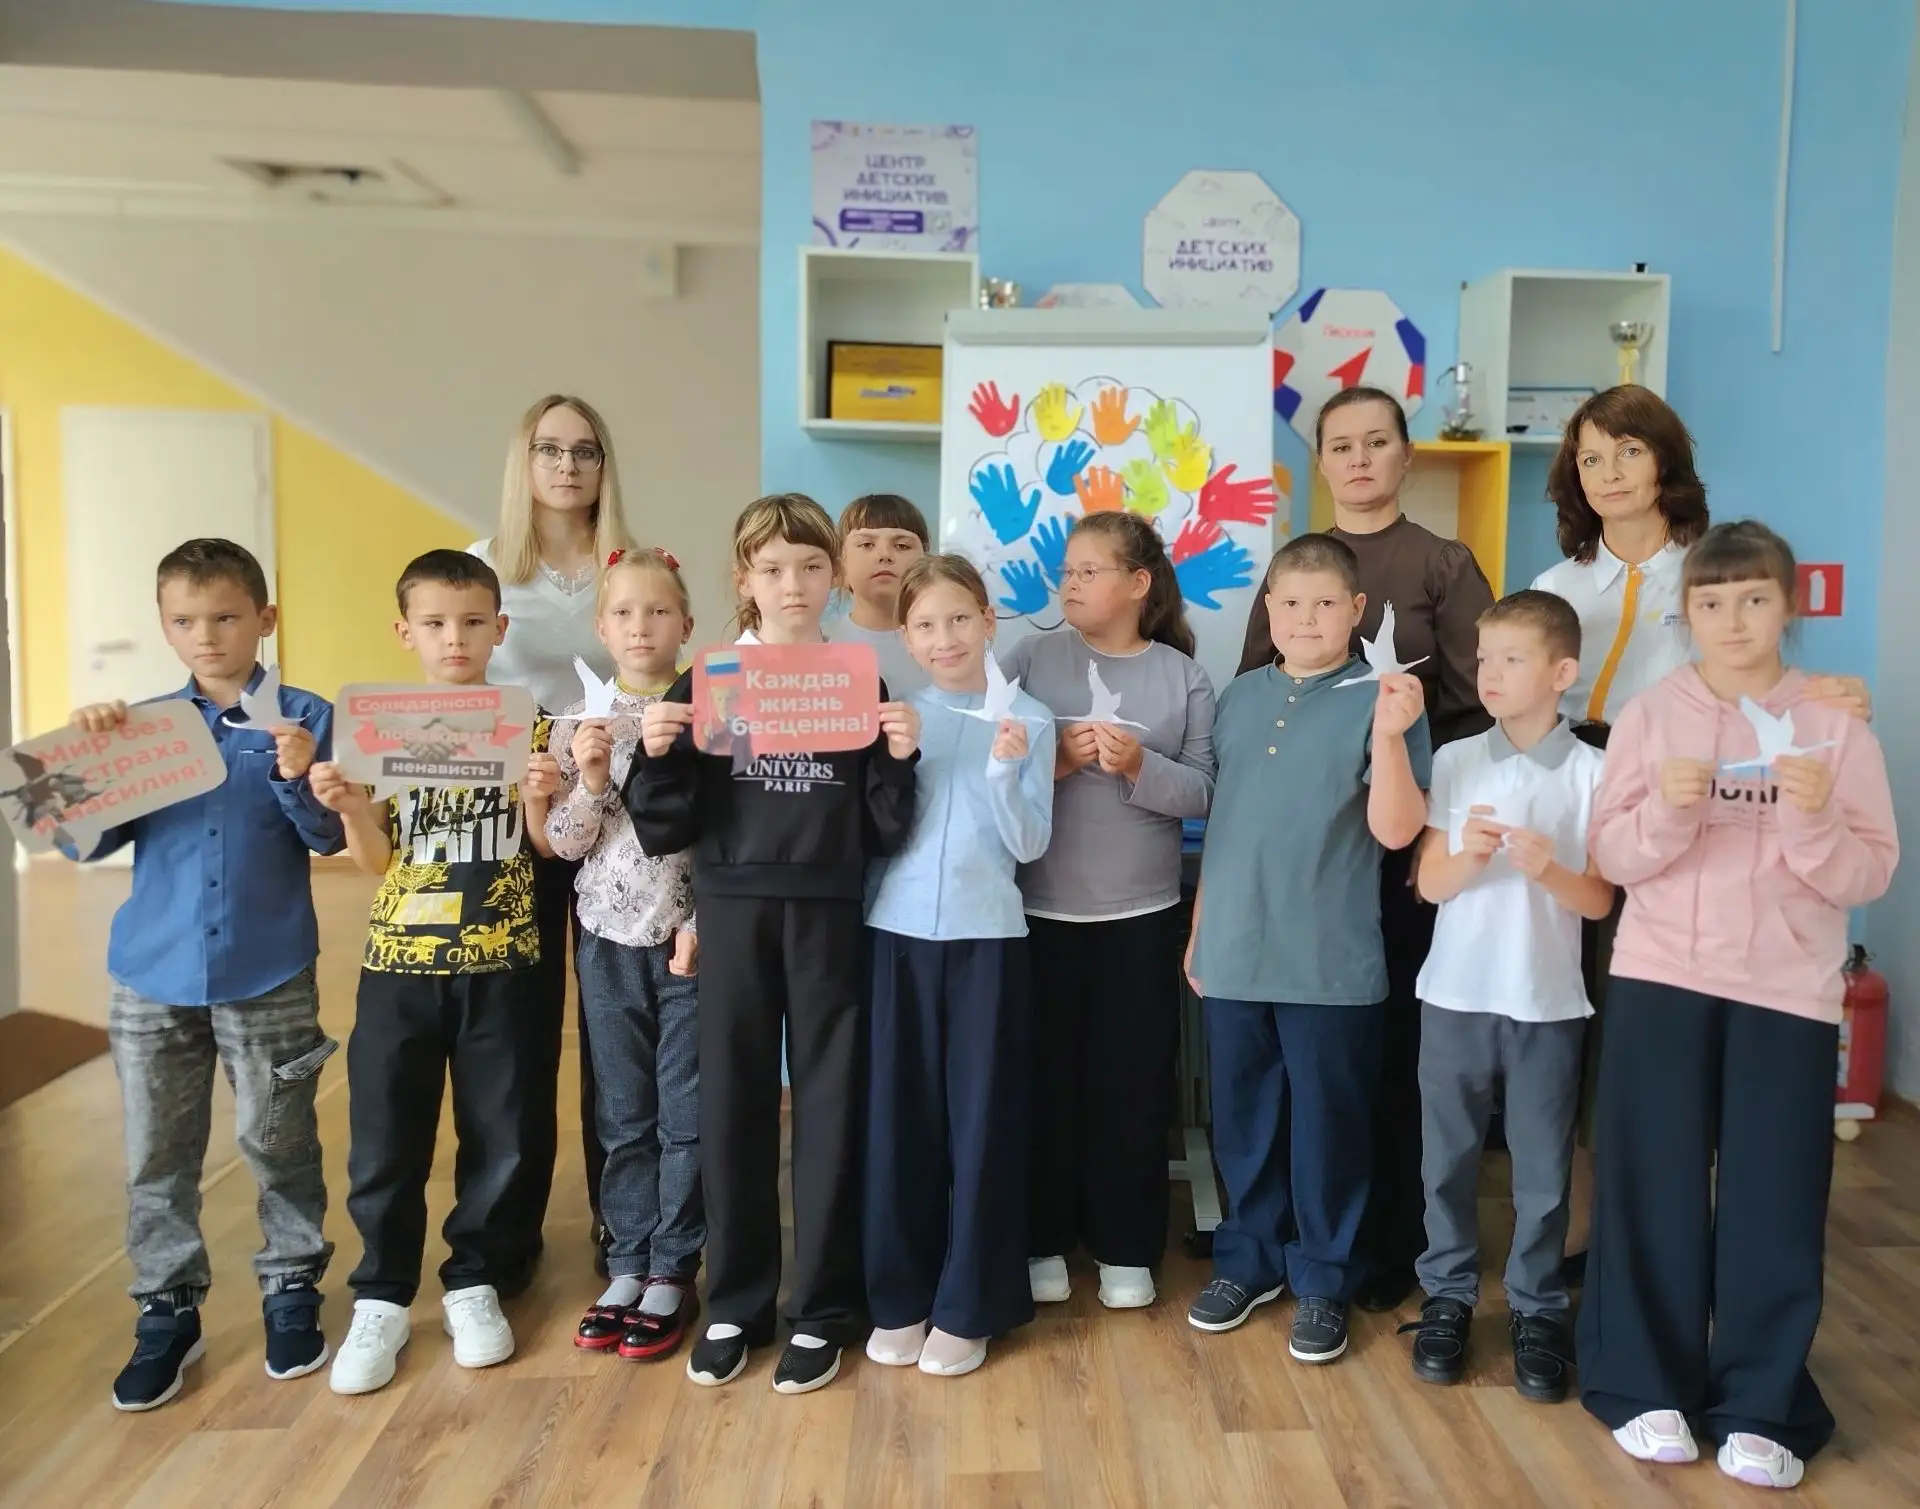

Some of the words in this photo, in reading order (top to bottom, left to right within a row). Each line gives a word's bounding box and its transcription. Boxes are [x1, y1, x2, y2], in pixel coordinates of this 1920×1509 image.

[865, 154, 926, 169] ЦЕНТР
[856, 172, 935, 186] ДЕТСКИХ
[1176, 240, 1267, 255] ДЕТСКИХ
[746, 669, 850, 691] Каждая
[356, 696, 495, 713] Солидарность
[760, 697, 843, 713] жизнь
[731, 713, 869, 738] бесценна!
[36, 731, 111, 770] Мир
[116, 715, 174, 741] без
[82, 739, 190, 783] страха
[391, 761, 496, 776] ненависть!
[746, 759, 834, 779] UNIVERS
[62, 757, 207, 822] насилия!
[764, 780, 811, 793] PARIS
